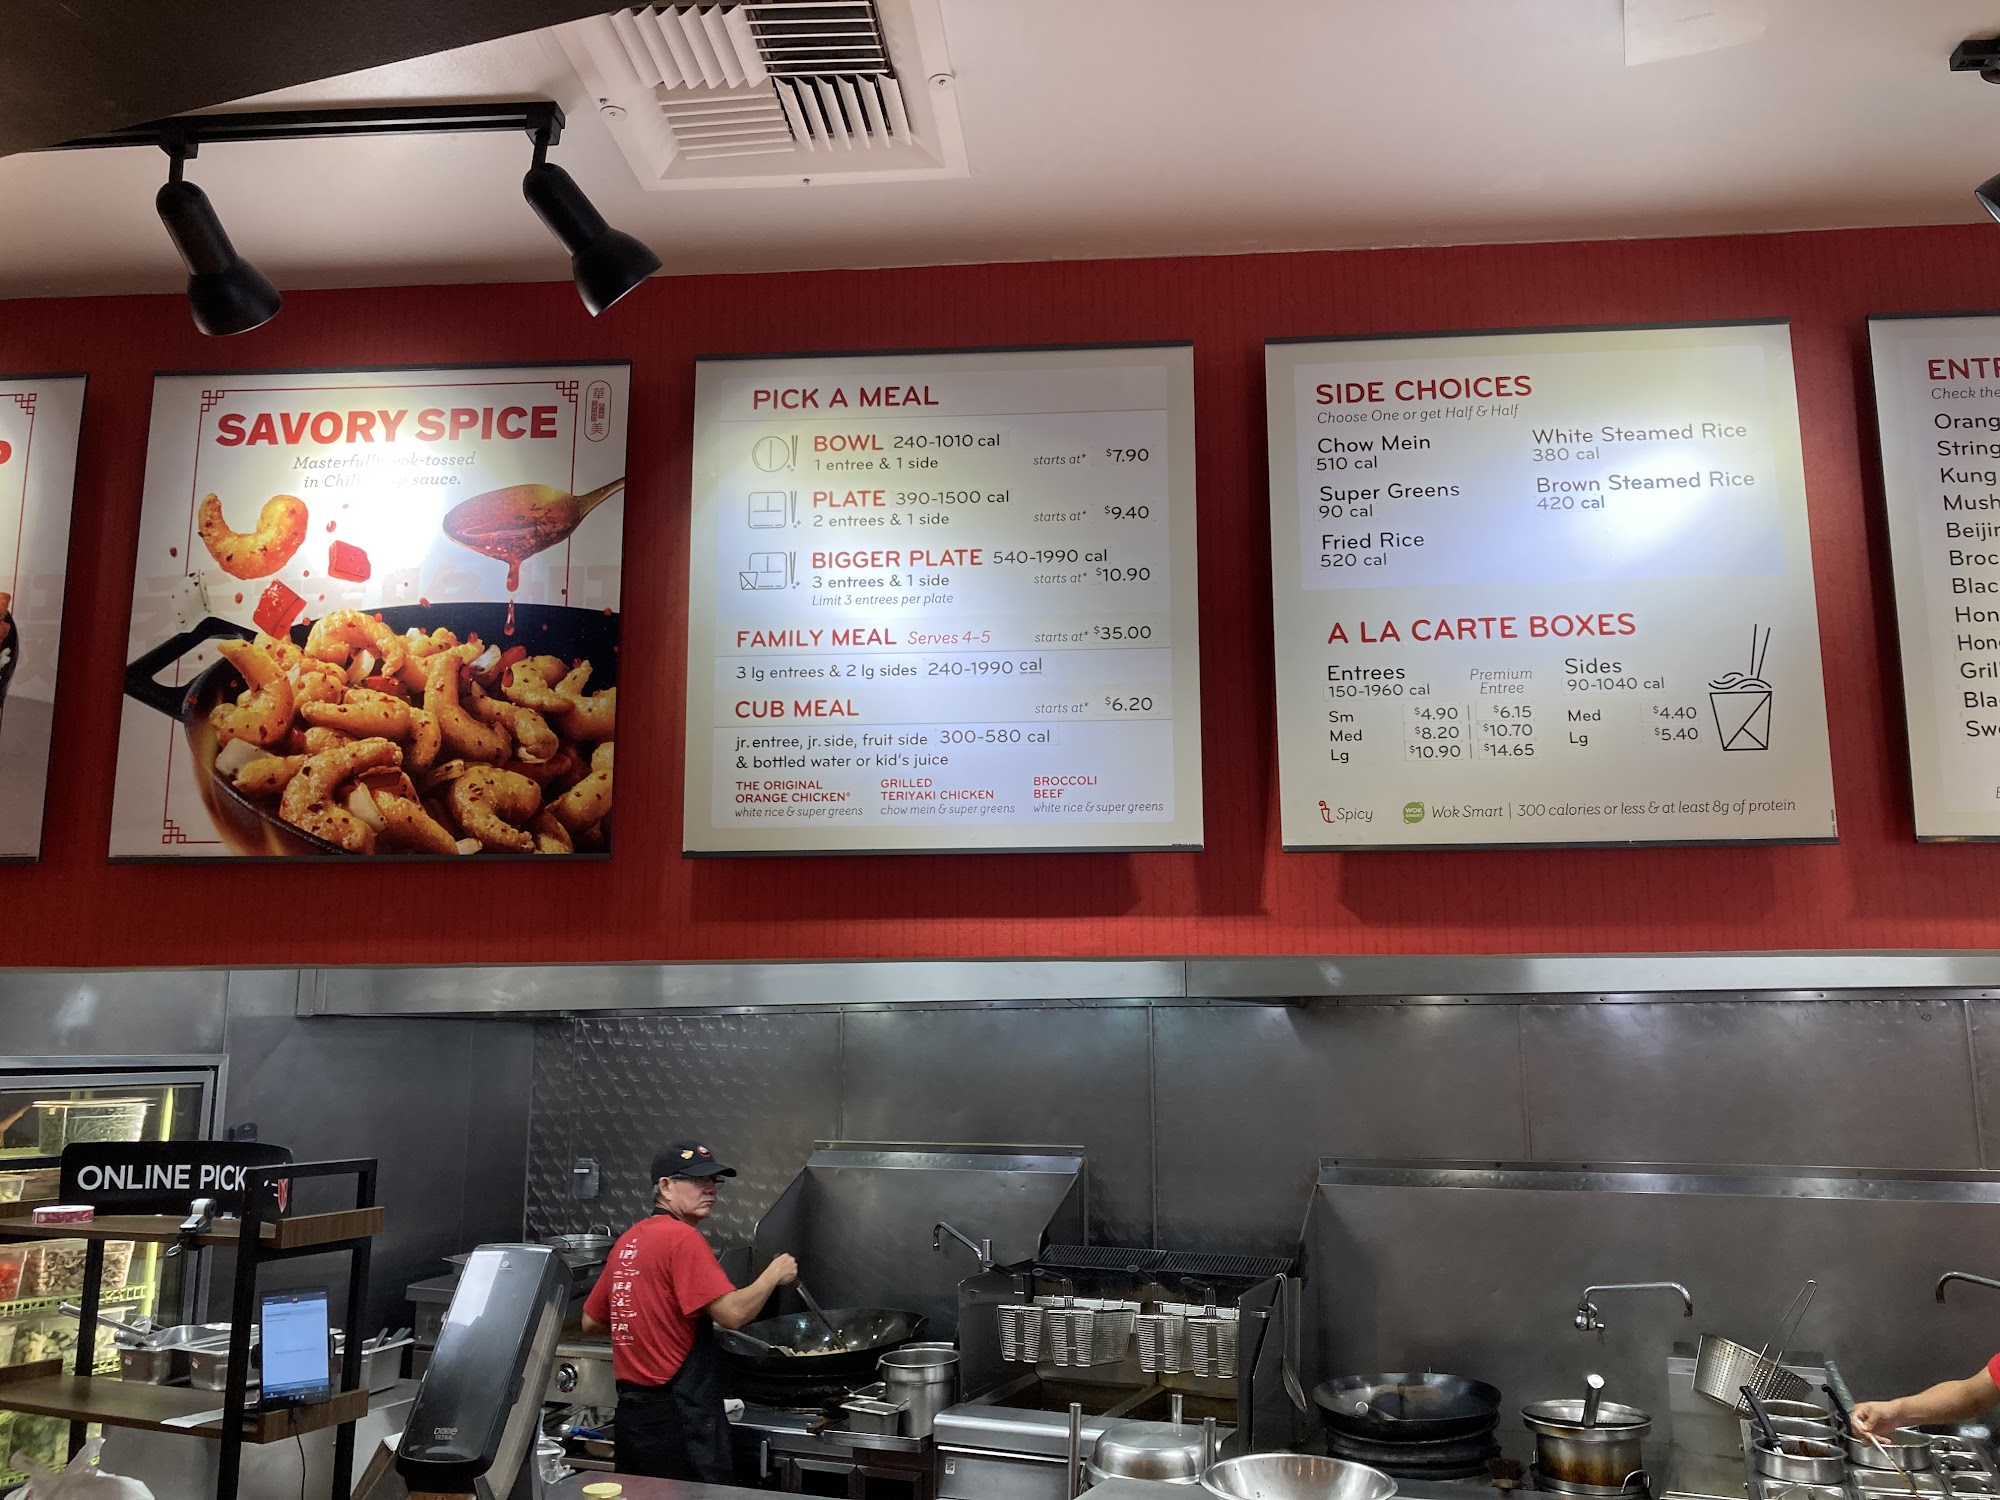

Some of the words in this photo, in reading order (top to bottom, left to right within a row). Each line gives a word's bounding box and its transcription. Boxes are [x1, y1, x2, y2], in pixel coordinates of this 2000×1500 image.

[754, 388, 819, 410] PICK
[829, 388, 848, 408] A
[860, 385, 939, 407] MEAL
[1316, 381, 1385, 405] SIDE
[1395, 375, 1532, 401] CHOICES
[1931, 386, 1976, 400] Check
[1317, 411, 1368, 424] Choose
[1371, 409, 1399, 422] One
[1403, 411, 1417, 420] or
[1420, 409, 1441, 423] get
[1445, 405, 1474, 421] Half
[1476, 405, 1488, 417] &
[1491, 403, 1520, 419] Half
[215, 410, 408, 447] SAVORY
[415, 405, 558, 441] SPICE
[1532, 428, 1593, 444] White
[1601, 423, 1693, 442] Steamed
[1701, 422, 1747, 439] Rice
[814, 434, 884, 452] BOWL
[893, 434, 973, 449] 240-1010
[978, 433, 1000, 447] cal
[1318, 437, 1374, 454] Chow
[1382, 435, 1430, 451] Mein
[1937, 440, 2000, 459] String
[1106, 448, 1149, 462] $7.90
[1532, 447, 1569, 462] 380
[1576, 446, 1600, 461] cal
[1316, 457, 1348, 471] 510
[1354, 455, 1377, 469] cal
[304, 476, 318, 488] in
[413, 475, 461, 485] sauce.
[1536, 477, 1600, 493] Brown
[1608, 471, 1701, 491] Steamed
[1709, 470, 1755, 487] Rice
[1940, 467, 1997, 486] Kung
[813, 490, 886, 508] PLATE
[896, 490, 981, 505] 390-1500
[987, 490, 1009, 503] cal
[1320, 486, 1380, 505] Super
[1388, 483, 1460, 499] Greens
[1536, 496, 1574, 510] 420
[1581, 495, 1605, 509] cal
[1943, 493, 2000, 511] Mush
[1104, 505, 1149, 520] $9.40
[1319, 505, 1343, 519] 90
[1350, 504, 1373, 518] cal
[1322, 533, 1371, 550] Fried
[1380, 532, 1424, 548] Rice
[812, 550, 900, 569] BIGGER
[910, 549, 983, 567] PLATE
[993, 549, 1078, 564] 540-1990
[1085, 549, 1107, 562] cal
[1321, 553, 1357, 568] 520
[1363, 552, 1387, 566] cal
[1096, 567, 1150, 582] $10.90
[1952, 577, 1999, 594] Blac
[812, 595, 842, 606] Limit
[844, 594, 852, 606] 3
[855, 595, 899, 605] entrees
[901, 596, 921, 607] per
[923, 592, 954, 607] plate
[1094, 625, 1151, 640] $35.00
[1328, 622, 1349, 644] A
[1360, 620, 1401, 643] LA
[1411, 617, 1518, 642] CARTE
[1529, 613, 1636, 638] BOXES
[737, 629, 824, 648] FAMILY
[832, 628, 897, 646] MEAL
[1957, 634, 2000, 651] Hon
[736, 666, 746, 679] 3
[752, 666, 764, 682] lg
[769, 667, 825, 679] entrees
[828, 664, 842, 678] &
[846, 664, 856, 677] 2
[861, 664, 874, 680] lg
[879, 664, 917, 677] sides
[928, 661, 1013, 676] 240-1990
[1019, 657, 1042, 671] cal
[1328, 665, 1405, 681] Entrees
[1565, 657, 1622, 674] Sides
[1960, 661, 2000, 679] Gril
[1470, 668, 1532, 681] Premium
[1328, 684, 1403, 698] 150-1960
[1409, 683, 1430, 696] cal
[1480, 681, 1524, 694] Entree
[1567, 677, 1638, 691] 90-1040
[1643, 677, 1665, 689] cal
[735, 700, 785, 718] CUB
[794, 699, 859, 717] MEAL
[1105, 696, 1153, 711] $6.20
[1329, 710, 1354, 723] Sm
[1414, 707, 1458, 720] $4.90
[1493, 705, 1532, 719] $6.15
[1568, 709, 1601, 722] Med
[1653, 705, 1697, 719] $4.40
[862, 733, 894, 746] fruit
[897, 732, 928, 746] side
[939, 729, 1021, 744] 300-580
[1027, 729, 1050, 743] cal
[1330, 729, 1362, 742] Med
[1415, 726, 1459, 740] $8.20
[1483, 723, 1533, 737] $10.70
[1569, 731, 1588, 747] Lg
[1654, 727, 1698, 741] $5.40
[736, 755, 748, 769] &
[753, 755, 805, 769] bottled
[810, 755, 851, 767] water
[856, 757, 871, 767] or
[876, 753, 910, 767] kid's
[913, 753, 949, 769] juice
[1331, 749, 1349, 764] Lg
[1409, 745, 1461, 758] $10.90
[1484, 743, 1535, 757] $14.65
[735, 781, 760, 791] THE
[763, 780, 823, 790] ORIGINAL
[880, 778, 933, 789] GRILLED
[1033, 775, 1097, 786] BROCCOLI
[735, 793, 788, 803] ORANGE
[880, 791, 936, 801] TERIYAKI
[940, 789, 994, 800] CHICKEN
[1033, 789, 1064, 799] BEEF
[880, 804, 908, 816] chow
[909, 804, 936, 815] mein
[937, 803, 948, 815] &
[948, 805, 978, 817] super
[979, 801, 1016, 817] greens
[1336, 807, 1373, 823] Spicy
[1432, 805, 1460, 818] Wok
[1462, 805, 1504, 818] Smart
[1517, 804, 1546, 817] 300
[1548, 803, 1601, 816] calories
[1603, 805, 1618, 815] or
[1621, 802, 1646, 815] less
[1647, 801, 1660, 814] &
[1662, 802, 1676, 814] at
[1678, 800, 1710, 814] least
[1712, 799, 1729, 816] 8g
[1732, 798, 1747, 815] of
[1748, 799, 1796, 815] protein
[77, 1164, 191, 1190] ONLINE
